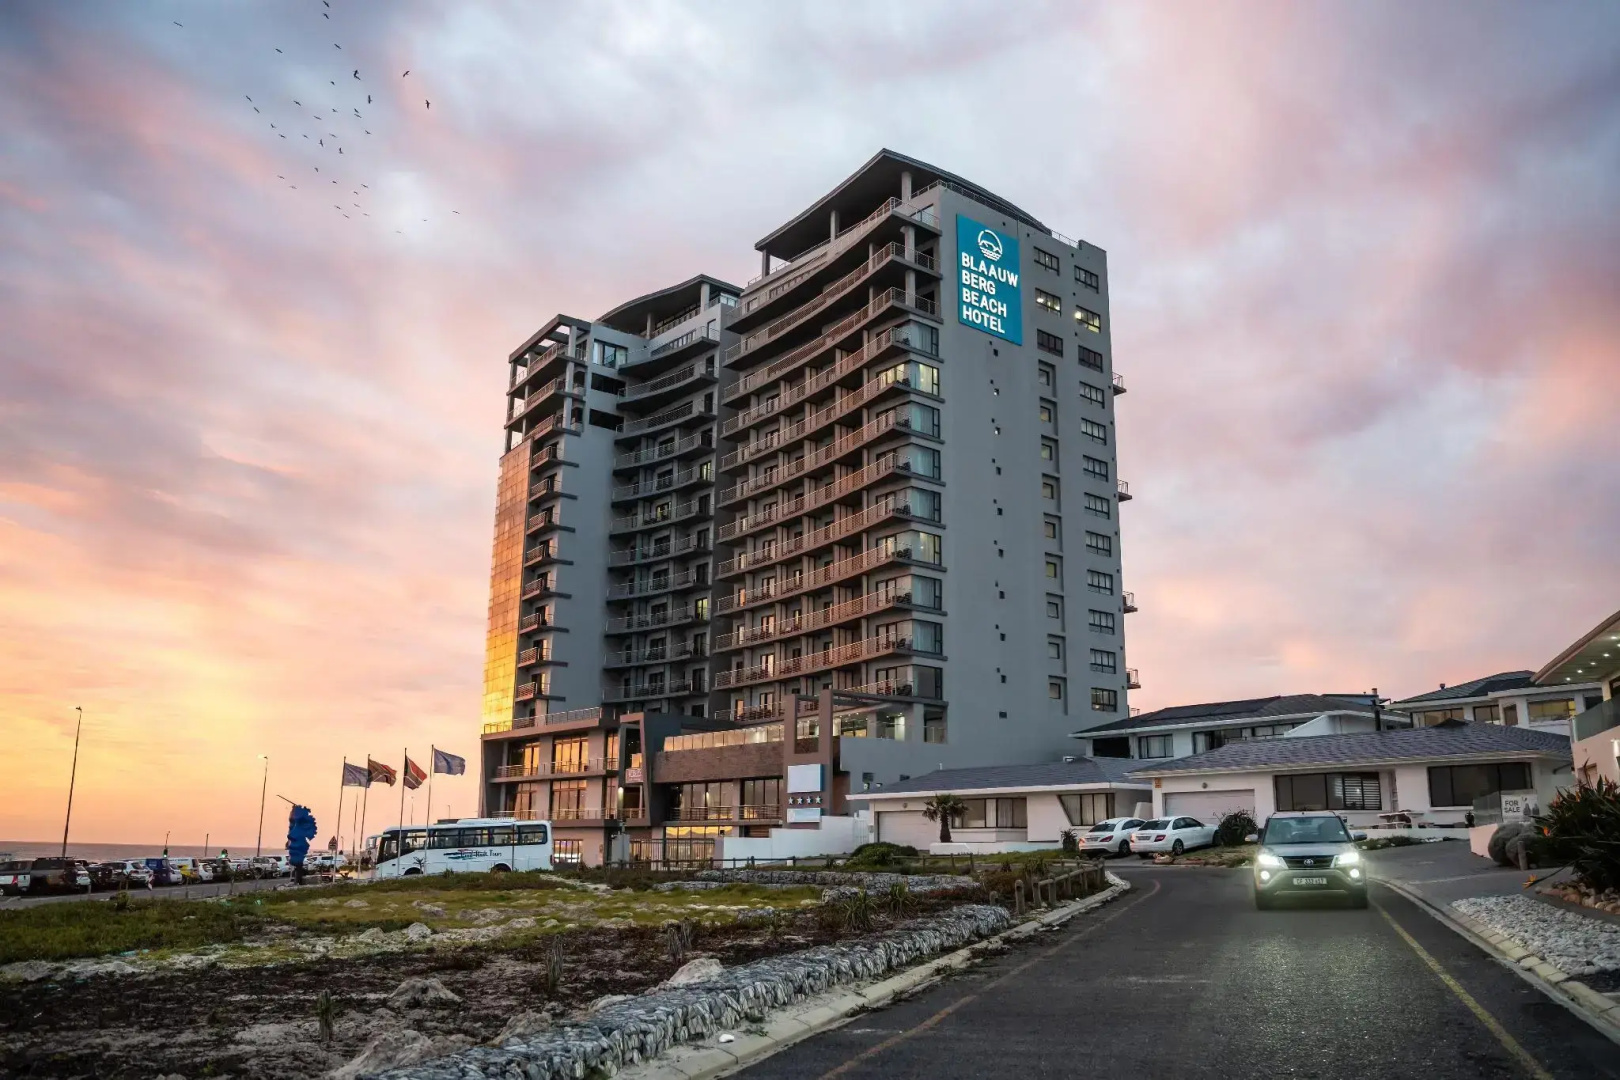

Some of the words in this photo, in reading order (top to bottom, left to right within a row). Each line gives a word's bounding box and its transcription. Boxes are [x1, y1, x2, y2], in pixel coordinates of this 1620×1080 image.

[961, 252, 1018, 288] BLAAUW
[961, 270, 996, 295] BERG
[962, 288, 1007, 318] BEACH
[962, 305, 1005, 334] HOTEL
